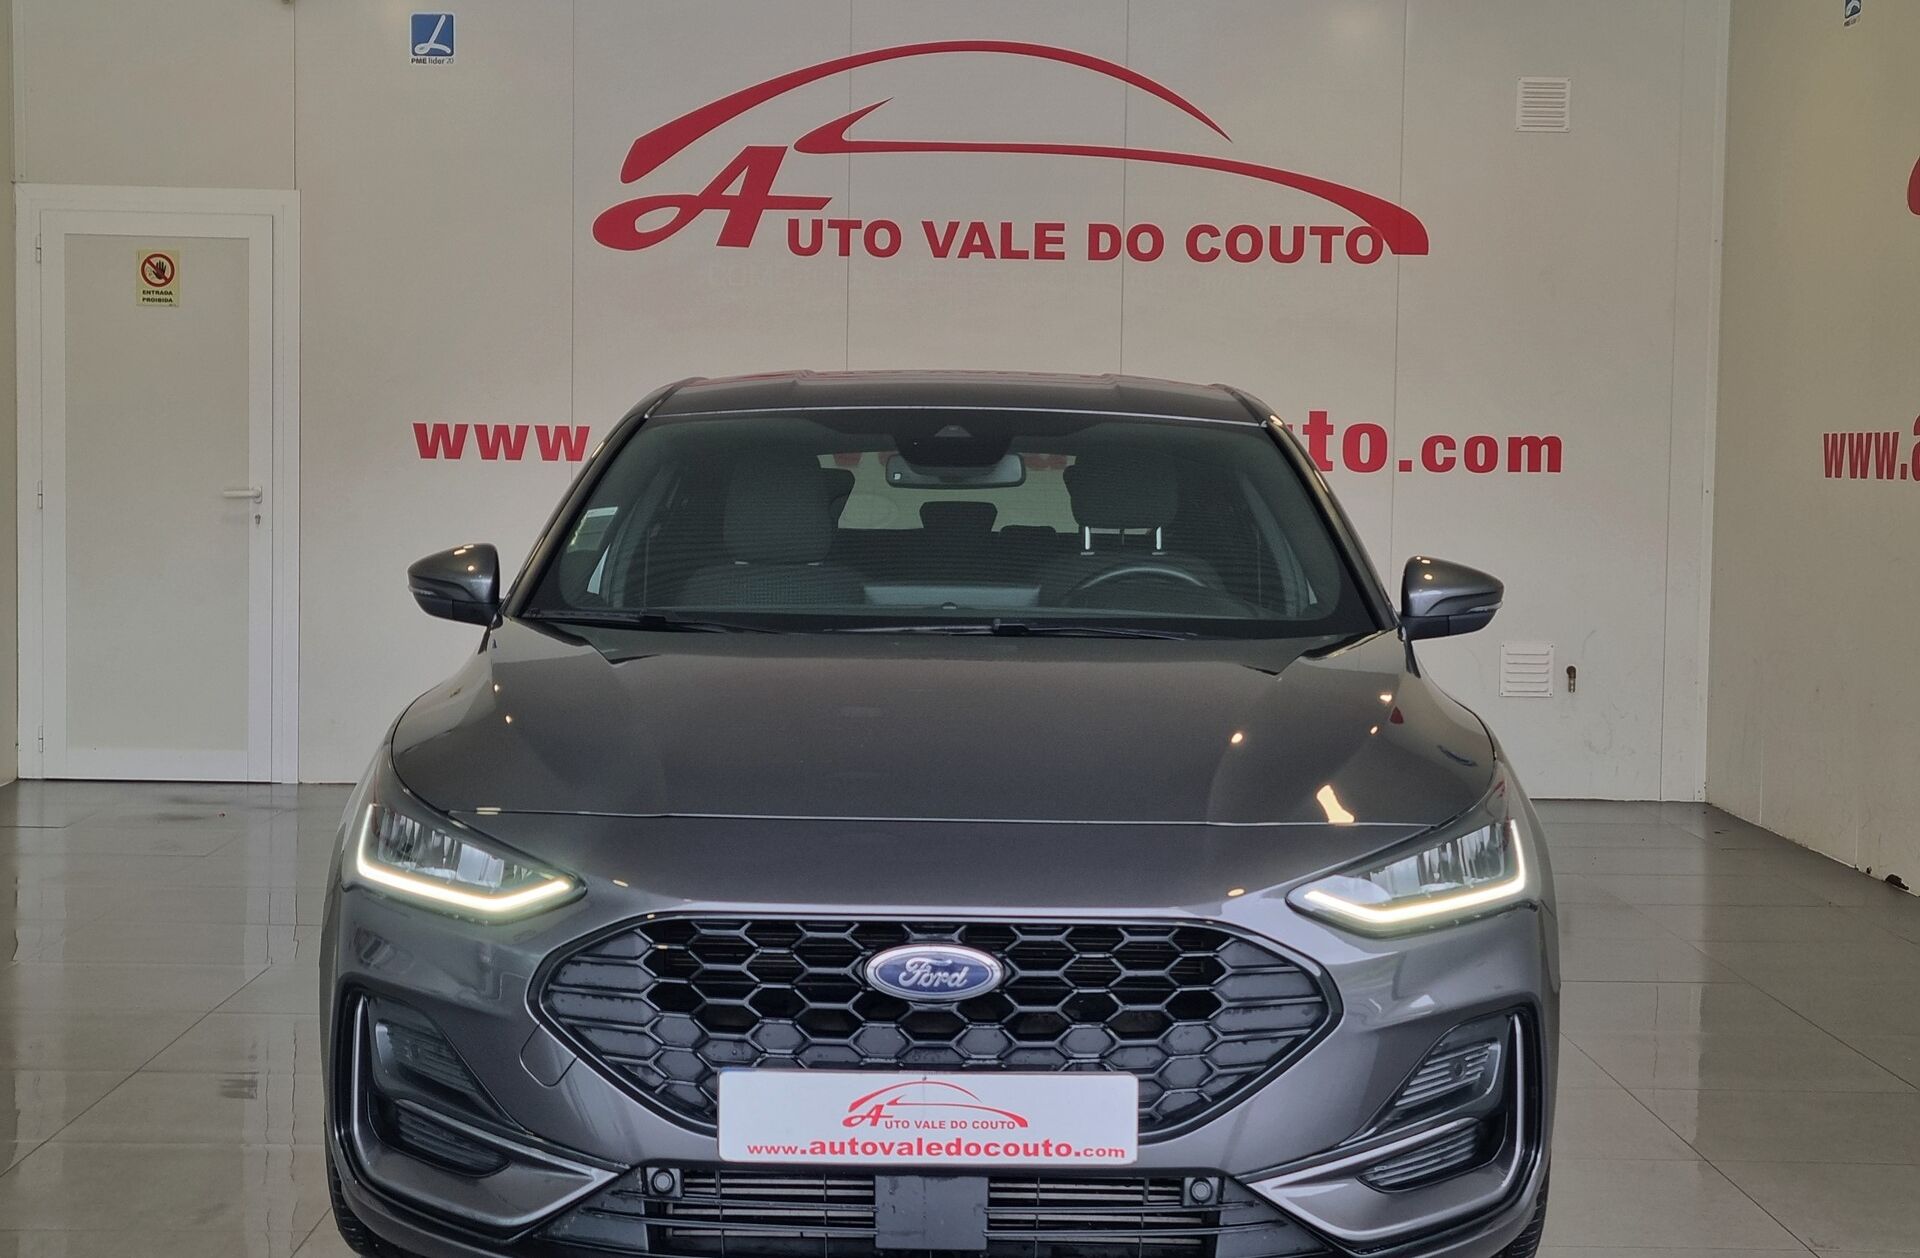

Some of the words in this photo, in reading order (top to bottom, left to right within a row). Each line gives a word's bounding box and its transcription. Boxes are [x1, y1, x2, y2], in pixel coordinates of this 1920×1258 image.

[592, 145, 902, 258] AUTO
[921, 219, 1066, 260] VALE
[1087, 222, 1165, 263] DO
[1185, 223, 1385, 265] COUTO
[1287, 410, 1563, 474] to.com
[898, 957, 969, 987] Ford
[842, 1104, 910, 1129] AUTO
[914, 1119, 946, 1130] VALE
[950, 1120, 968, 1130] DO
[972, 1120, 1016, 1130] COUTO
[747, 1137, 1125, 1159] www.autovaledocouto.com
